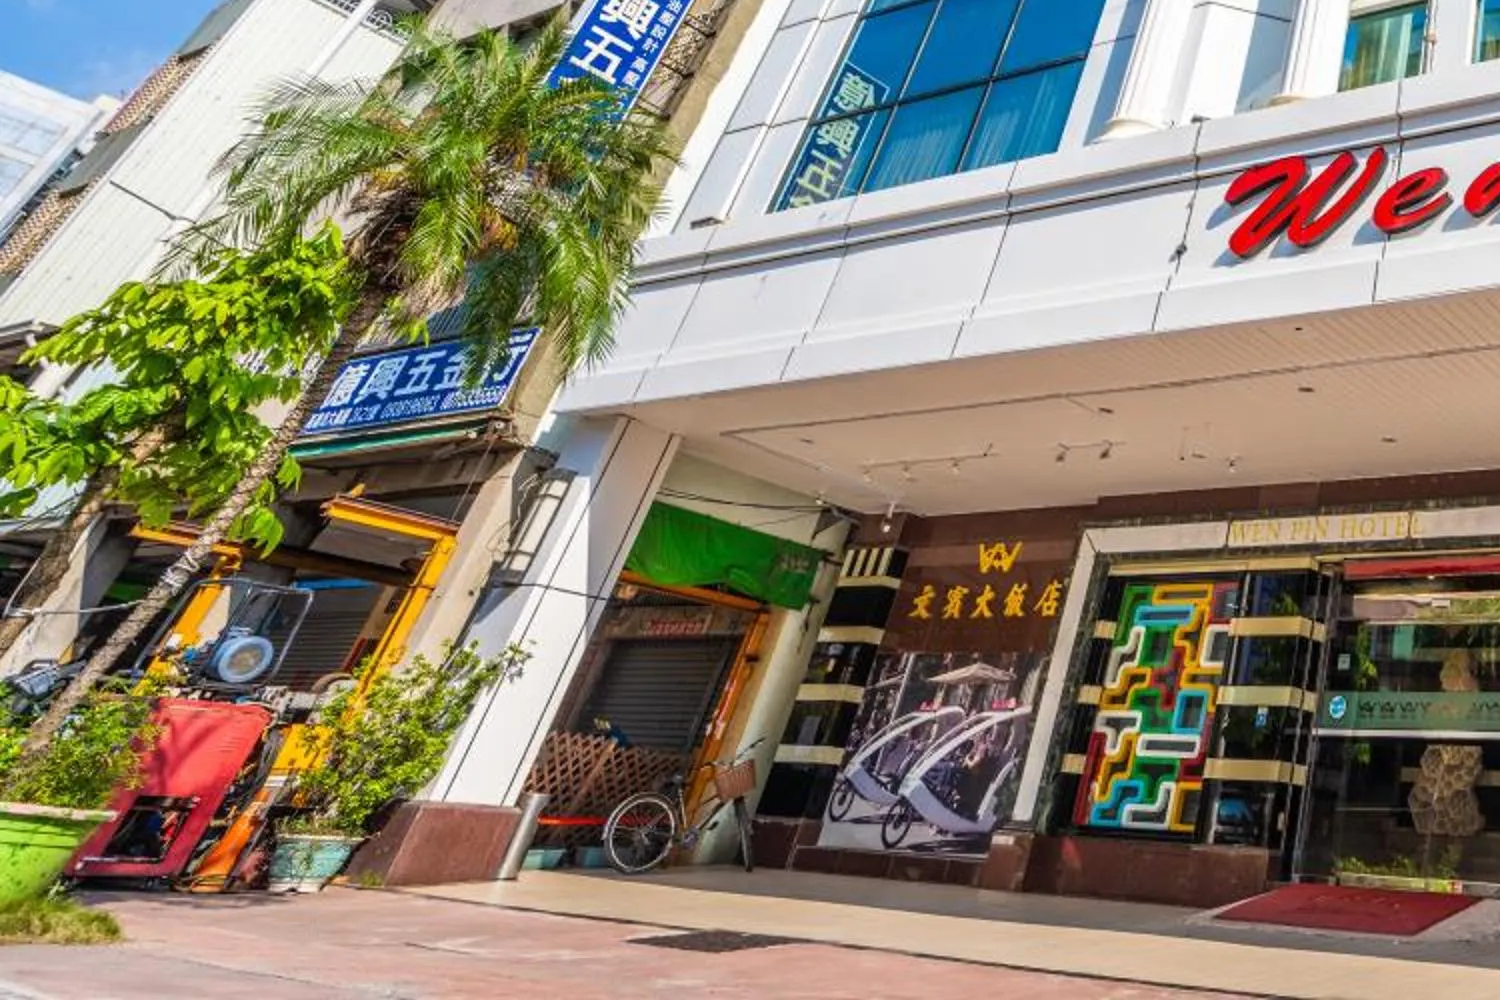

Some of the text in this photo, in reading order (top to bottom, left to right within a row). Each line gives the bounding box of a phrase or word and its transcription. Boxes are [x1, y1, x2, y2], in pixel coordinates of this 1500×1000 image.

[1231, 512, 1424, 544] WEN PIN HOTEL
[907, 579, 1063, 619] 文賓大飯店
